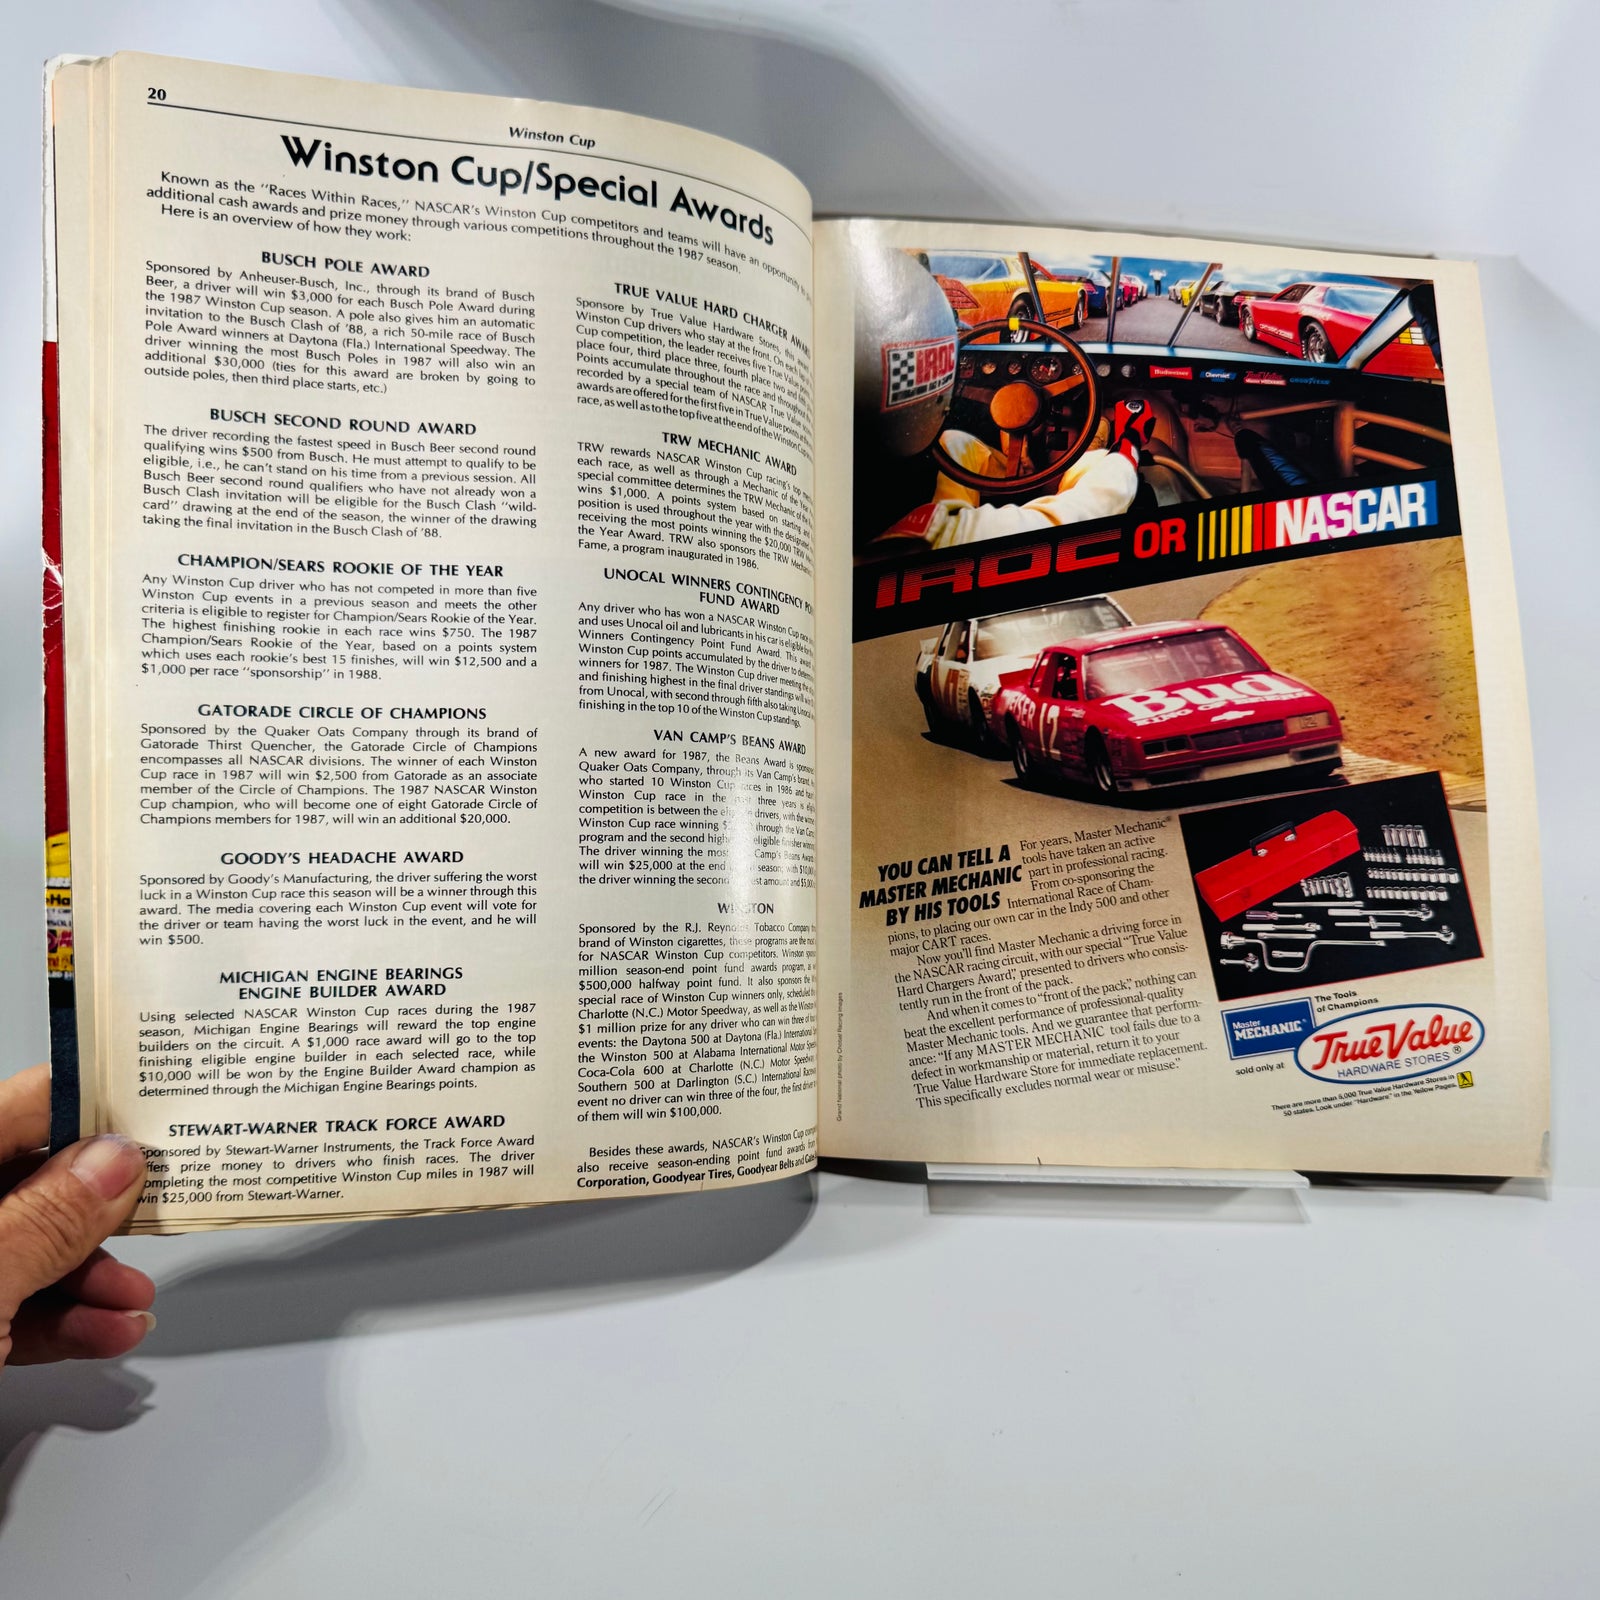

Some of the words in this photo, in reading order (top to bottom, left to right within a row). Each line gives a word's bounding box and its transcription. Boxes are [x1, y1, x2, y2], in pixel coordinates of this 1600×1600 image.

[147, 87, 167, 101] 20
[508, 126, 564, 143] Winston
[569, 134, 596, 150] Cup
[279, 134, 438, 183] Winston
[451, 155, 657, 208] Cup/Special
[669, 186, 774, 245] Awards
[161, 203, 195, 218] Here
[198, 207, 209, 220] is
[212, 212, 228, 222] an
[232, 214, 293, 229] overview
[296, 219, 310, 231] of
[313, 220, 342, 234] how
[344, 223, 372, 240] they
[375, 228, 411, 241] work:
[261, 250, 316, 268] BUSCH
[324, 257, 363, 273] POLE
[370, 262, 430, 277] AWARD
[614, 282, 649, 299] TRUE
[655, 289, 698, 309] VALUE
[703, 299, 738, 319] HARD
[742, 312, 788, 340] CHARGER
[210, 407, 266, 424] BUSCH
[274, 413, 341, 429] SECOND
[349, 418, 410, 433] ROUND
[417, 422, 477, 435] AWARD
[661, 431, 692, 447] TRW
[697, 437, 760, 462] MECHANIC
[764, 454, 797, 476] AWARD
[875, 529, 1122, 608] IROC
[1133, 517, 1186, 559] OR
[1275, 484, 1426, 547] NASCAR
[177, 553, 325, 573] CHAMPION/SEARS
[332, 561, 394, 575] ROOKIE
[400, 563, 422, 575] OF
[429, 564, 458, 576] THE
[465, 564, 503, 577] YEAR
[603, 567, 665, 584] UNOCAL
[671, 573, 731, 592] WINNERS
[735, 582, 803, 609] CONTINGENCY
[699, 591, 735, 606] FUND
[740, 597, 780, 615] AWARD
[141, 662, 186, 675] $1,000
[189, 666, 210, 677] per
[213, 667, 239, 677] race
[333, 668, 344, 679] in
[348, 669, 381, 680] 1988.
[1100, 673, 1304, 722] Bud
[197, 703, 291, 718] GATORADE
[298, 706, 353, 719] CIRCLE
[360, 706, 383, 719] OF
[389, 707, 486, 720] CHAMPIONS
[1040, 702, 1061, 754] 12
[653, 729, 683, 742] VAN
[741, 734, 775, 749] BEANS
[778, 739, 806, 755] AWARD
[1019, 839, 1037, 851] For
[1039, 836, 1072, 850] years,
[1074, 829, 1111, 843] Master
[308, 851, 396, 864] HEADACHE
[403, 850, 464, 863] AWARD
[877, 860, 913, 882] YOU
[917, 853, 953, 875] CAN
[957, 848, 993, 868] TELL
[997, 844, 1011, 862] A
[858, 880, 927, 909] MASTER
[931, 864, 1022, 896] MECHANIC
[886, 905, 910, 927] BY
[914, 900, 942, 922] HIS
[946, 890, 1000, 916] TOOLS
[138, 934, 162, 945] win
[167, 934, 203, 946] $500.
[219, 970, 308, 984] MICHIGAN
[317, 968, 377, 982] ENGINE
[385, 966, 463, 980] BEARINGS
[239, 986, 301, 1000] ENGINE
[309, 984, 377, 998] BUILDER
[385, 983, 446, 997] AWARD
[1315, 994, 1332, 1003] The
[1333, 990, 1357, 1000] Tools
[1316, 1004, 1326, 1013] of
[1326, 997, 1379, 1011] Champions
[1232, 1020, 1261, 1030] Master
[1234, 1020, 1302, 1041] MECHANIC
[1235, 1065, 1254, 1075] sold
[1255, 1063, 1274, 1073] only
[1275, 1061, 1285, 1069] at
[1337, 1060, 1401, 1078] HARDWARE
[1405, 1052, 1450, 1067] STORES
[915, 1095, 942, 1109] This
[943, 1085, 1002, 1106] specifically
[1005, 1078, 1052, 1095] excludes
[1053, 1071, 1092, 1087] normal
[1093, 1069, 1120, 1081] wear
[1122, 1067, 1134, 1076] or
[576, 1110, 589, 1122] of
[591, 1110, 619, 1121] them
[622, 1108, 643, 1120] will
[646, 1108, 667, 1119] win
[669, 1104, 722, 1118] $100,000.
[168, 1120, 318, 1137] STEWART-WARNER
[325, 1118, 378, 1133] TRACK
[386, 1116, 437, 1131] FORCE
[443, 1114, 505, 1129] AWARD
